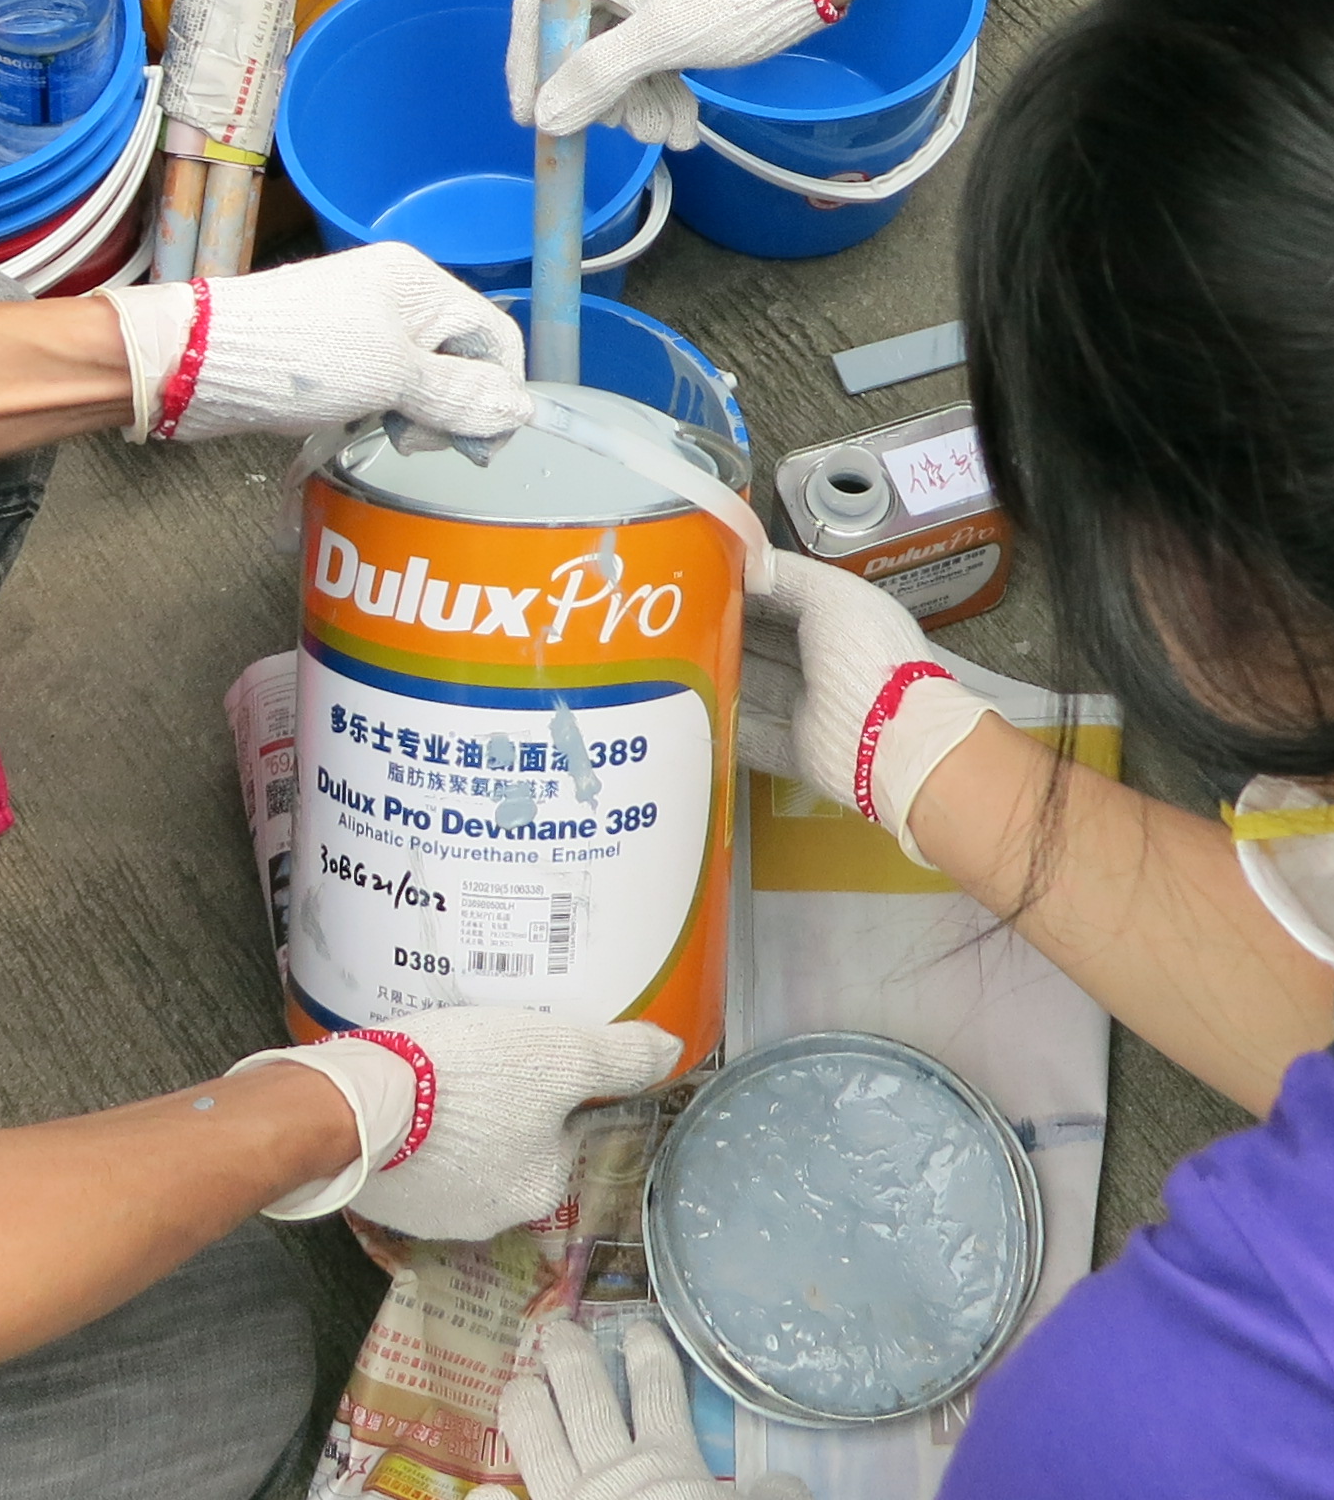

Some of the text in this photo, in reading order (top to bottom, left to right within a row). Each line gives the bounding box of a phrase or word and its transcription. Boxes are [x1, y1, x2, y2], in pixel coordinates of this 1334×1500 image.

[863, 540, 949, 575] Dulux
[946, 526, 996, 550] Pro
[314, 525, 541, 638] Dulux
[546, 552, 684, 645] Pro
[329, 703, 570, 773] 多乐士专业油面
[589, 735, 649, 769] 389
[317, 765, 376, 817] Dulux
[383, 794, 432, 831] Pro
[605, 801, 658, 835] 389
[337, 811, 621, 864] Aliphatic Polyurethane Enamel
[394, 946, 451, 976] D389
